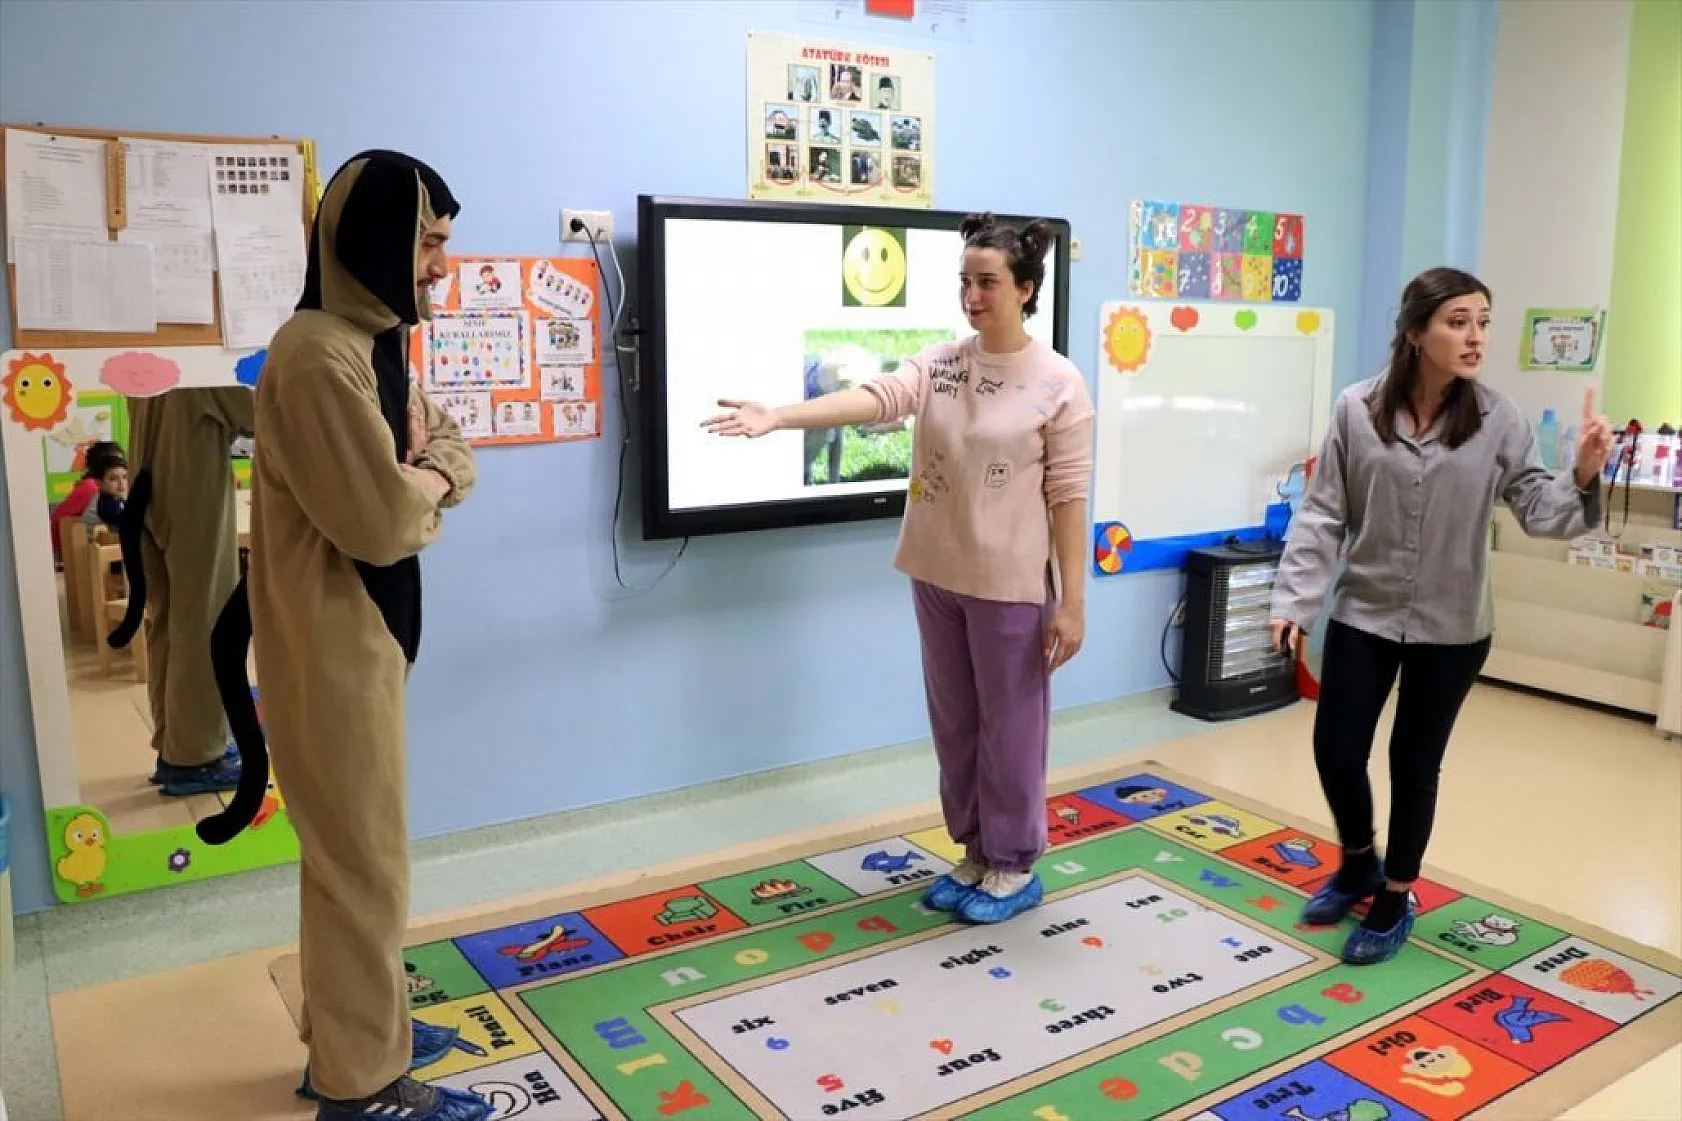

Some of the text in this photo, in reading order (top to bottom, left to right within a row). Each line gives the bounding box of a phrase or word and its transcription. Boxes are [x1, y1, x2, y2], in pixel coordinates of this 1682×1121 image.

[801, 46, 852, 63] ATATÜRK
[1181, 207, 1196, 233] 2
[1214, 209, 1227, 235] 3
[1245, 214, 1258, 238] 4
[1274, 215, 1287, 240] 5
[1272, 273, 1289, 296] 10
[886, 868, 936, 885] Fish
[1125, 894, 1162, 909] ten
[1200, 867, 1243, 888] w
[1247, 895, 1284, 912] x
[646, 923, 718, 947] Chair
[1040, 917, 1089, 938] nine
[515, 953, 594, 977] Plane
[660, 966, 706, 988] n
[733, 948, 770, 966] o
[796, 931, 836, 954] p
[940, 944, 1003, 969] eight
[1233, 945, 1273, 962] one
[823, 978, 899, 1006] seven
[1152, 971, 1203, 993] two
[412, 989, 449, 1004] og
[464, 1004, 516, 1050] Pencil
[731, 1015, 776, 1034] six
[1045, 1005, 1116, 1034] three
[594, 1017, 646, 1050] m
[765, 1036, 791, 1051] 6
[1220, 1027, 1264, 1051] c
[937, 1048, 1002, 1077] four
[523, 1070, 562, 1105] Hen
[816, 1073, 845, 1093] 5
[1099, 1076, 1139, 1101] e
[657, 1079, 711, 1116] k
[821, 1088, 886, 1116] five
[1252, 1081, 1316, 1110] Tree
